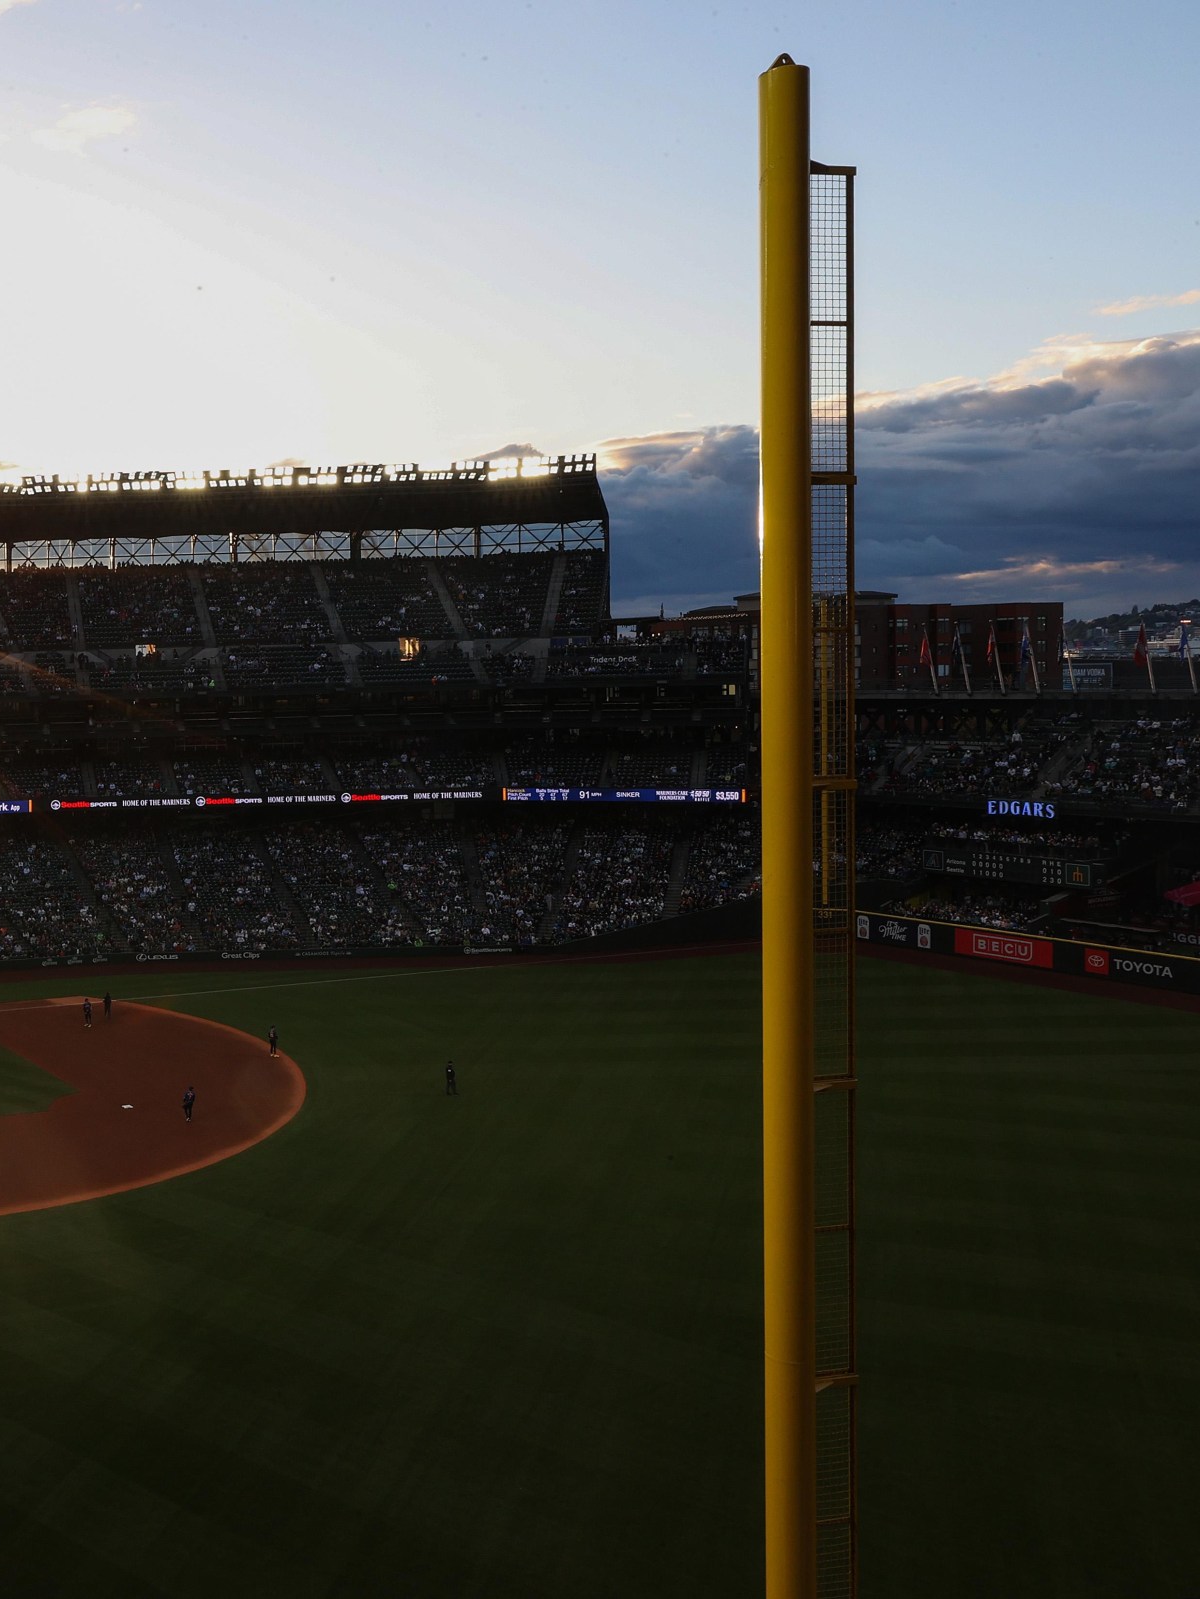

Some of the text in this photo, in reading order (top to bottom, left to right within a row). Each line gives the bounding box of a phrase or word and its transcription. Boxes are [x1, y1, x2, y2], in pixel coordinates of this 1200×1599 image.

[579, 790, 590, 799] 91
[716, 792, 739, 801] $3,550
[978, 940, 1028, 956] BECU
[243, 951, 260, 960] Clips
[1113, 958, 1173, 978] TOYOTA
